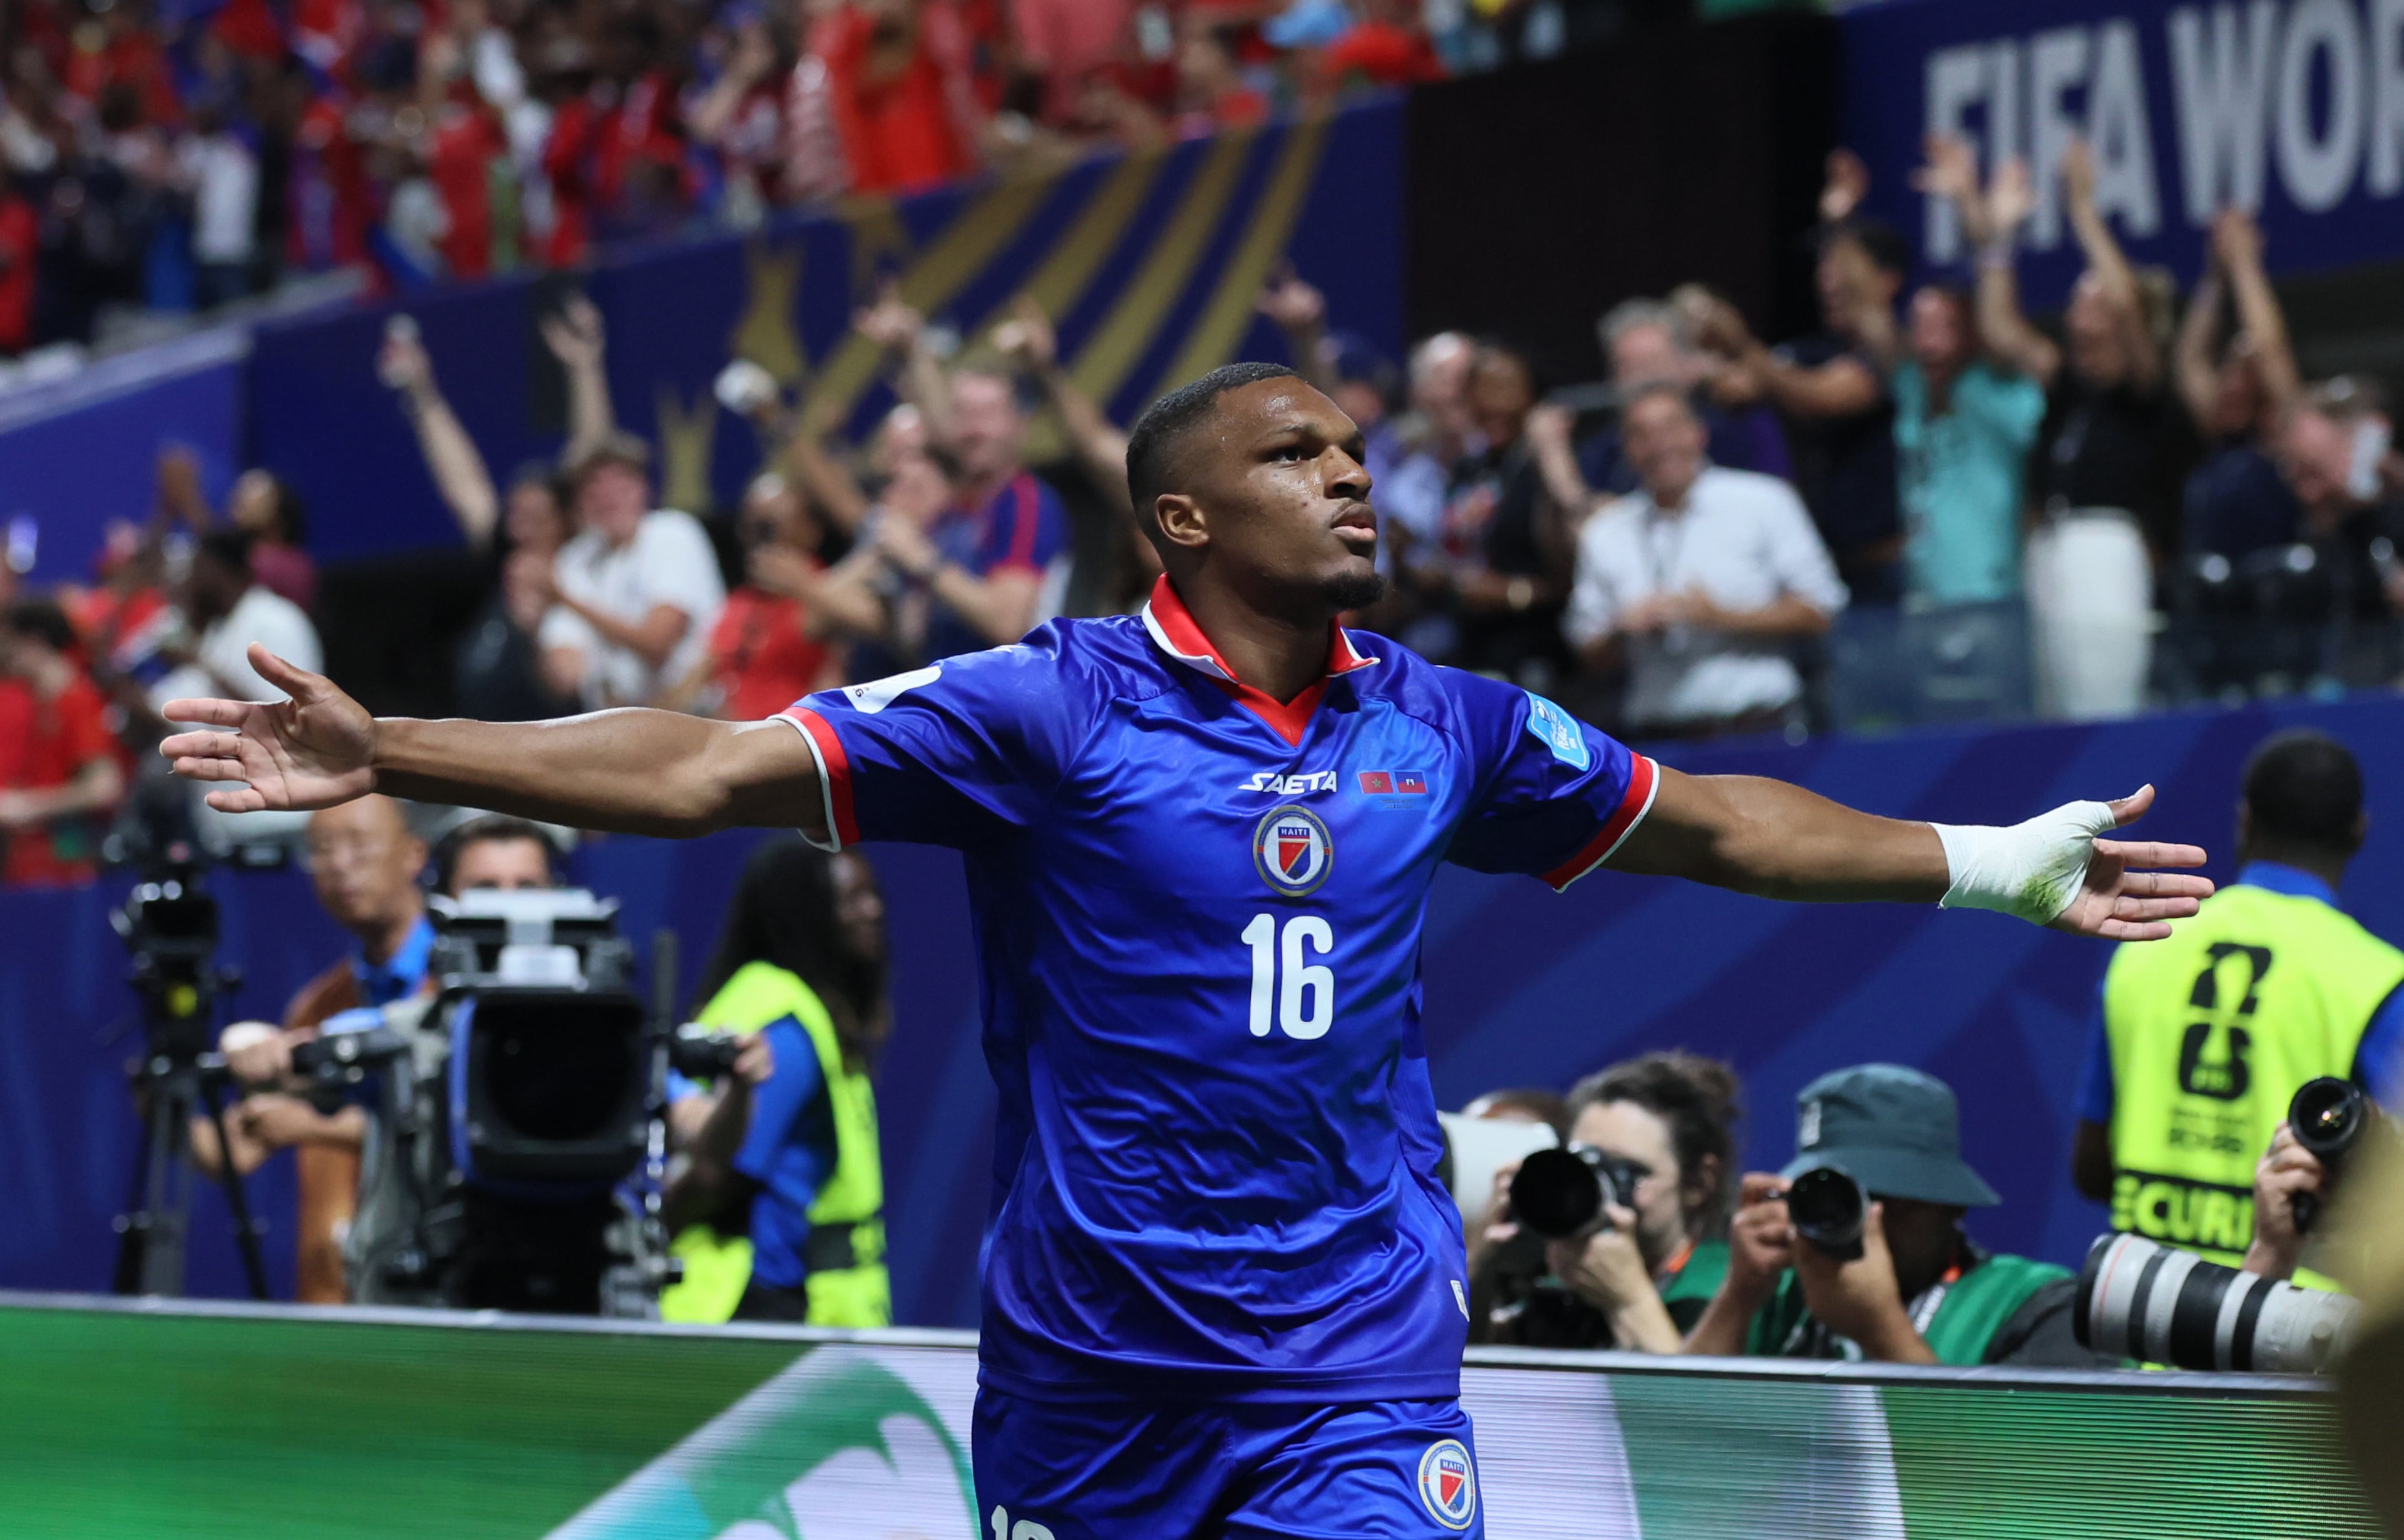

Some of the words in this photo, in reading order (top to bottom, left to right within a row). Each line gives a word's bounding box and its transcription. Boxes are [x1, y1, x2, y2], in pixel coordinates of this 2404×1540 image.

[1928, 20, 2161, 264] FIFA
[1237, 770, 1337, 795] SAETA
[1281, 828, 1307, 836] HAITI
[1240, 913, 1335, 1040] 16
[1442, 1460, 1463, 1471] HAITI
